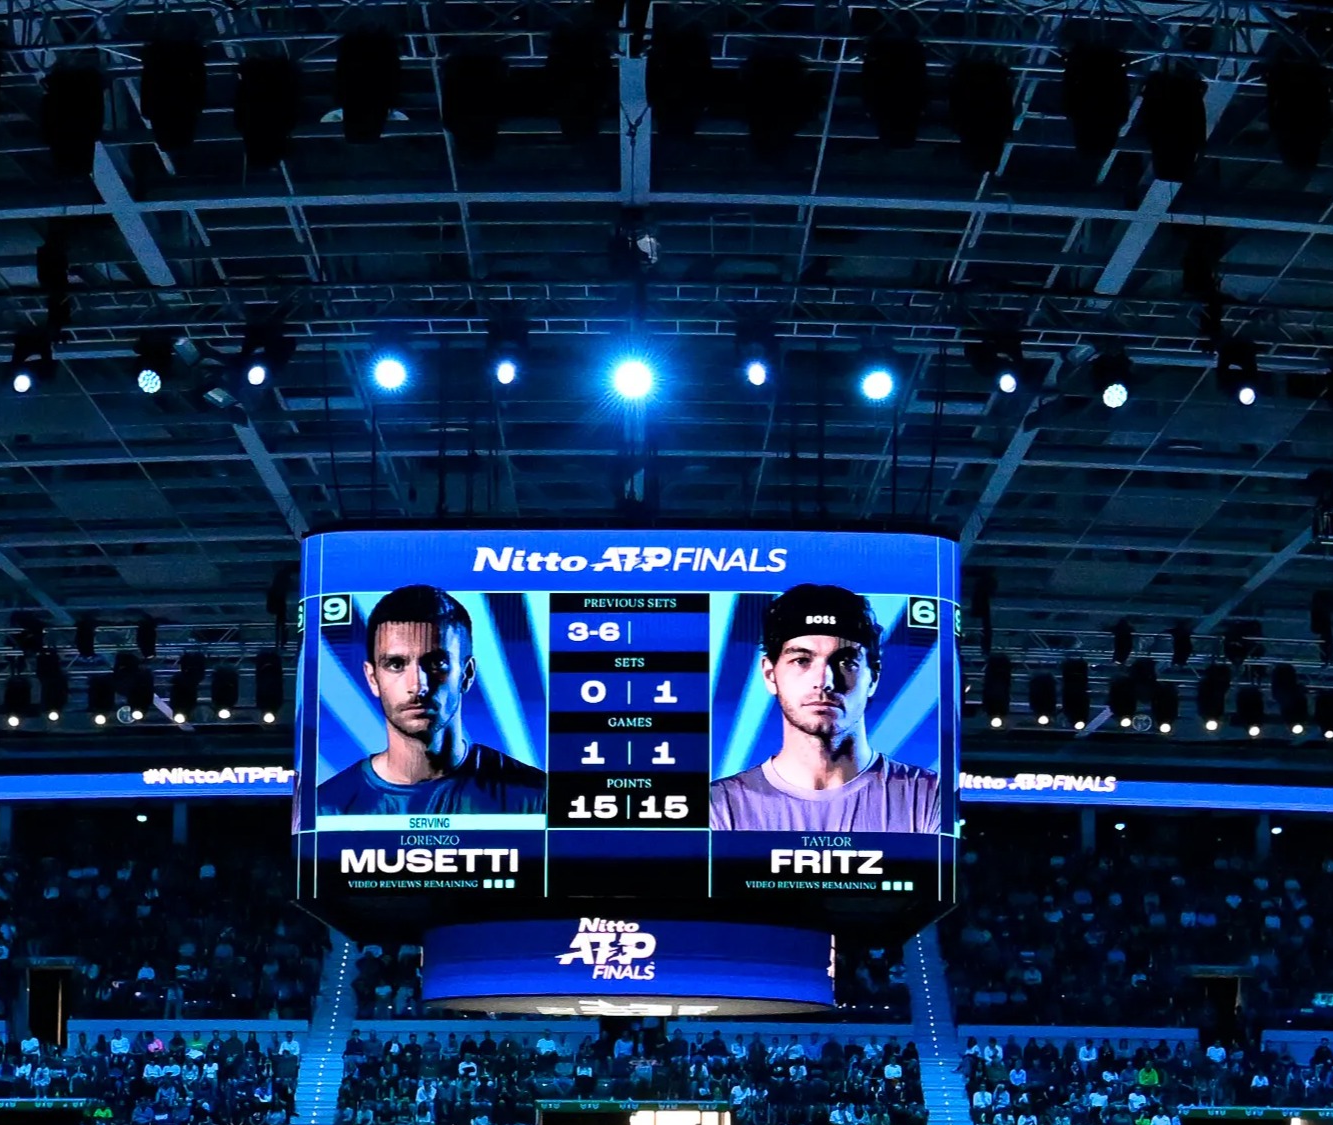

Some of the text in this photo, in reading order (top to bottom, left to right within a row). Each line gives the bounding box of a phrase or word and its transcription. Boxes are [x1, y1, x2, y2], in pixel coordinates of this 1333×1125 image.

[472, 547, 788, 573] Nitto ATP FINALS
[323, 597, 348, 621] 9
[584, 598, 677, 608] PREVIOUS SETS
[805, 615, 837, 625] BOSS
[912, 600, 936, 624] 6
[567, 621, 620, 642] 3-6
[614, 657, 645, 668] SETS
[580, 680, 678, 704] 0 1
[607, 717, 653, 728] GAMES
[581, 741, 676, 765] 1 1
[606, 778, 652, 789] POINTS
[1053, 774, 1117, 792] FINALS
[568, 795, 689, 819] 15 15
[409, 817, 450, 829] SERVING
[400, 835, 460, 846] LORENZO
[801, 836, 852, 847] TAYLOR
[340, 848, 519, 874] MUSETTI
[770, 849, 884, 875] FRITZ
[348, 880, 479, 889] VIDEO REVIEWS REMAINING
[745, 881, 877, 890] VIDEO REVIEWS REMAINING
[578, 917, 640, 933] Nitto
[555, 932, 657, 966] ATP
[592, 964, 656, 981] FINALS
